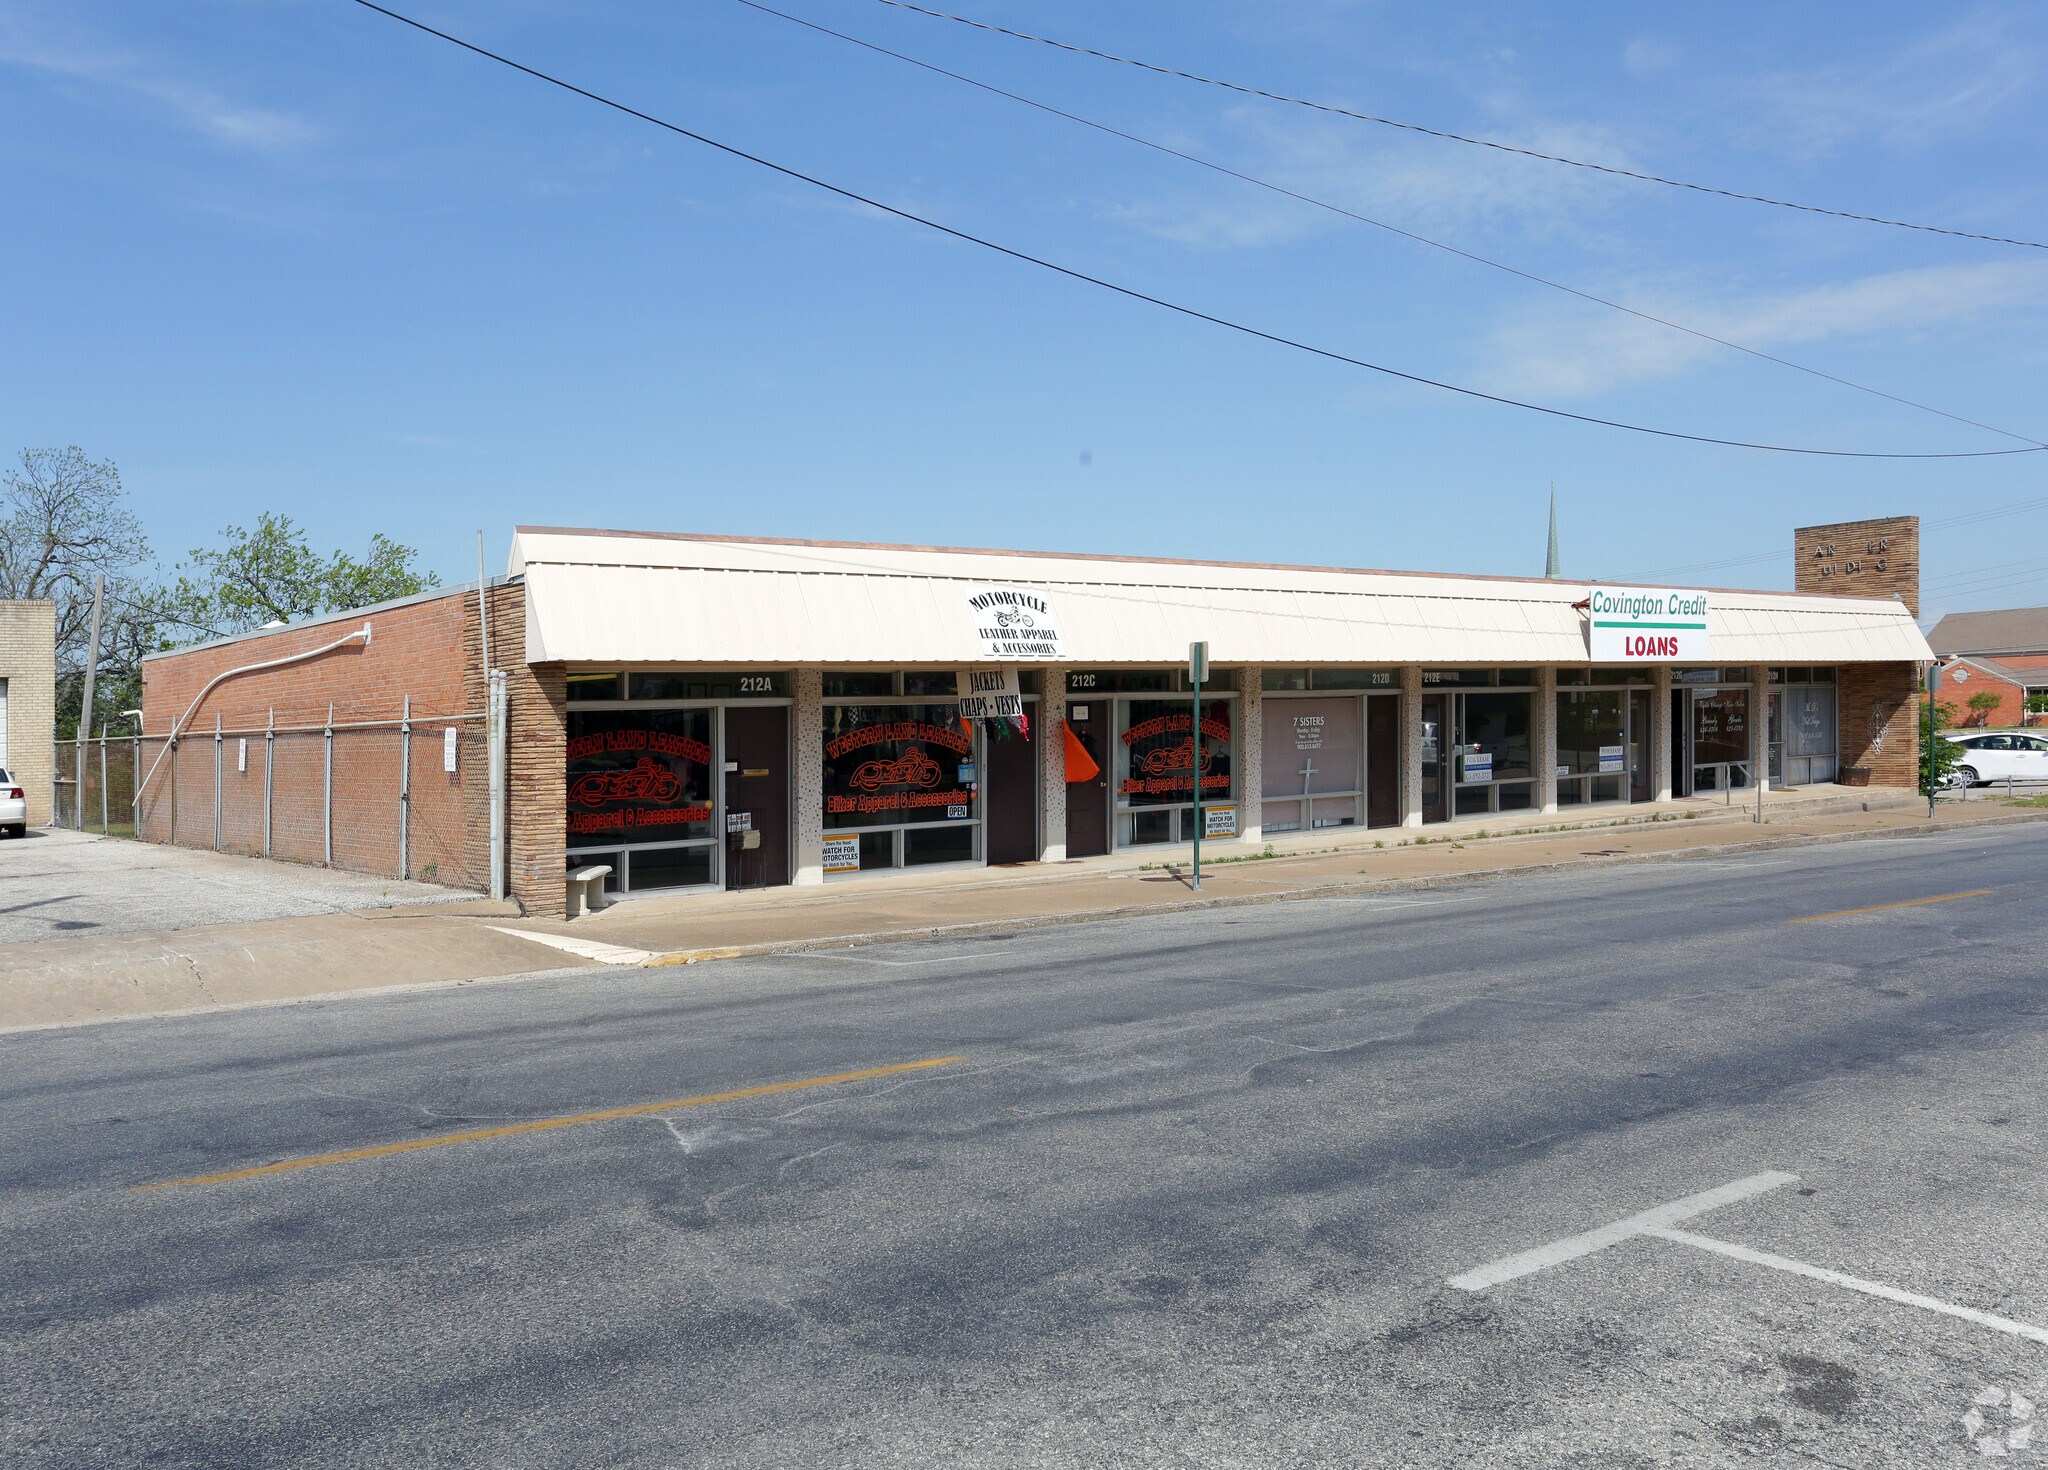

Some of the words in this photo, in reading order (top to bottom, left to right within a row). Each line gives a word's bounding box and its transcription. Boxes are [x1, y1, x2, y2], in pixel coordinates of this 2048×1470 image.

[968, 591, 1048, 615] MOTORCYCLE
[1593, 591, 1662, 619] Covington
[1668, 593, 1707, 616] Credit
[979, 628, 1019, 640] LEATHER
[1020, 629, 1059, 641] APPAREL
[992, 642, 1001, 653] &
[1002, 642, 1056, 654] ACCESSORIES
[1625, 636, 1678, 656] LOANS
[740, 677, 773, 691] 212A
[969, 671, 1005, 694] JACKETS
[1071, 674, 1096, 687] 212C
[1372, 673, 1390, 684] 212D
[1424, 672, 1440, 683] 212E
[960, 697, 988, 717] CHAPS
[995, 695, 1021, 715] VESTS
[1293, 717, 1298, 727] 7
[1299, 716, 1325, 726] SISTERS
[1121, 716, 1165, 747] WESTERN
[1166, 714, 1191, 731] LAND
[606, 730, 647, 750] LAND
[648, 731, 712, 765] LEATHER
[825, 724, 884, 759] WESTERN
[886, 722, 917, 741] LAND
[919, 723, 971, 754] LEATHER
[1477, 755, 1489, 763] LEASE
[1122, 777, 1145, 793] Biker
[1146, 775, 1177, 794] Apparel
[1184, 773, 1230, 790] Acessories
[828, 795, 857, 813] Biker
[858, 791, 899, 814] Apparel
[908, 789, 968, 808] Accessories
[572, 808, 625, 833] Apparel
[635, 804, 711, 826] Accessories
[948, 806, 967, 816] OPEN
[822, 847, 842, 855] WATCH
[822, 853, 858, 862] OTORCYCLES
